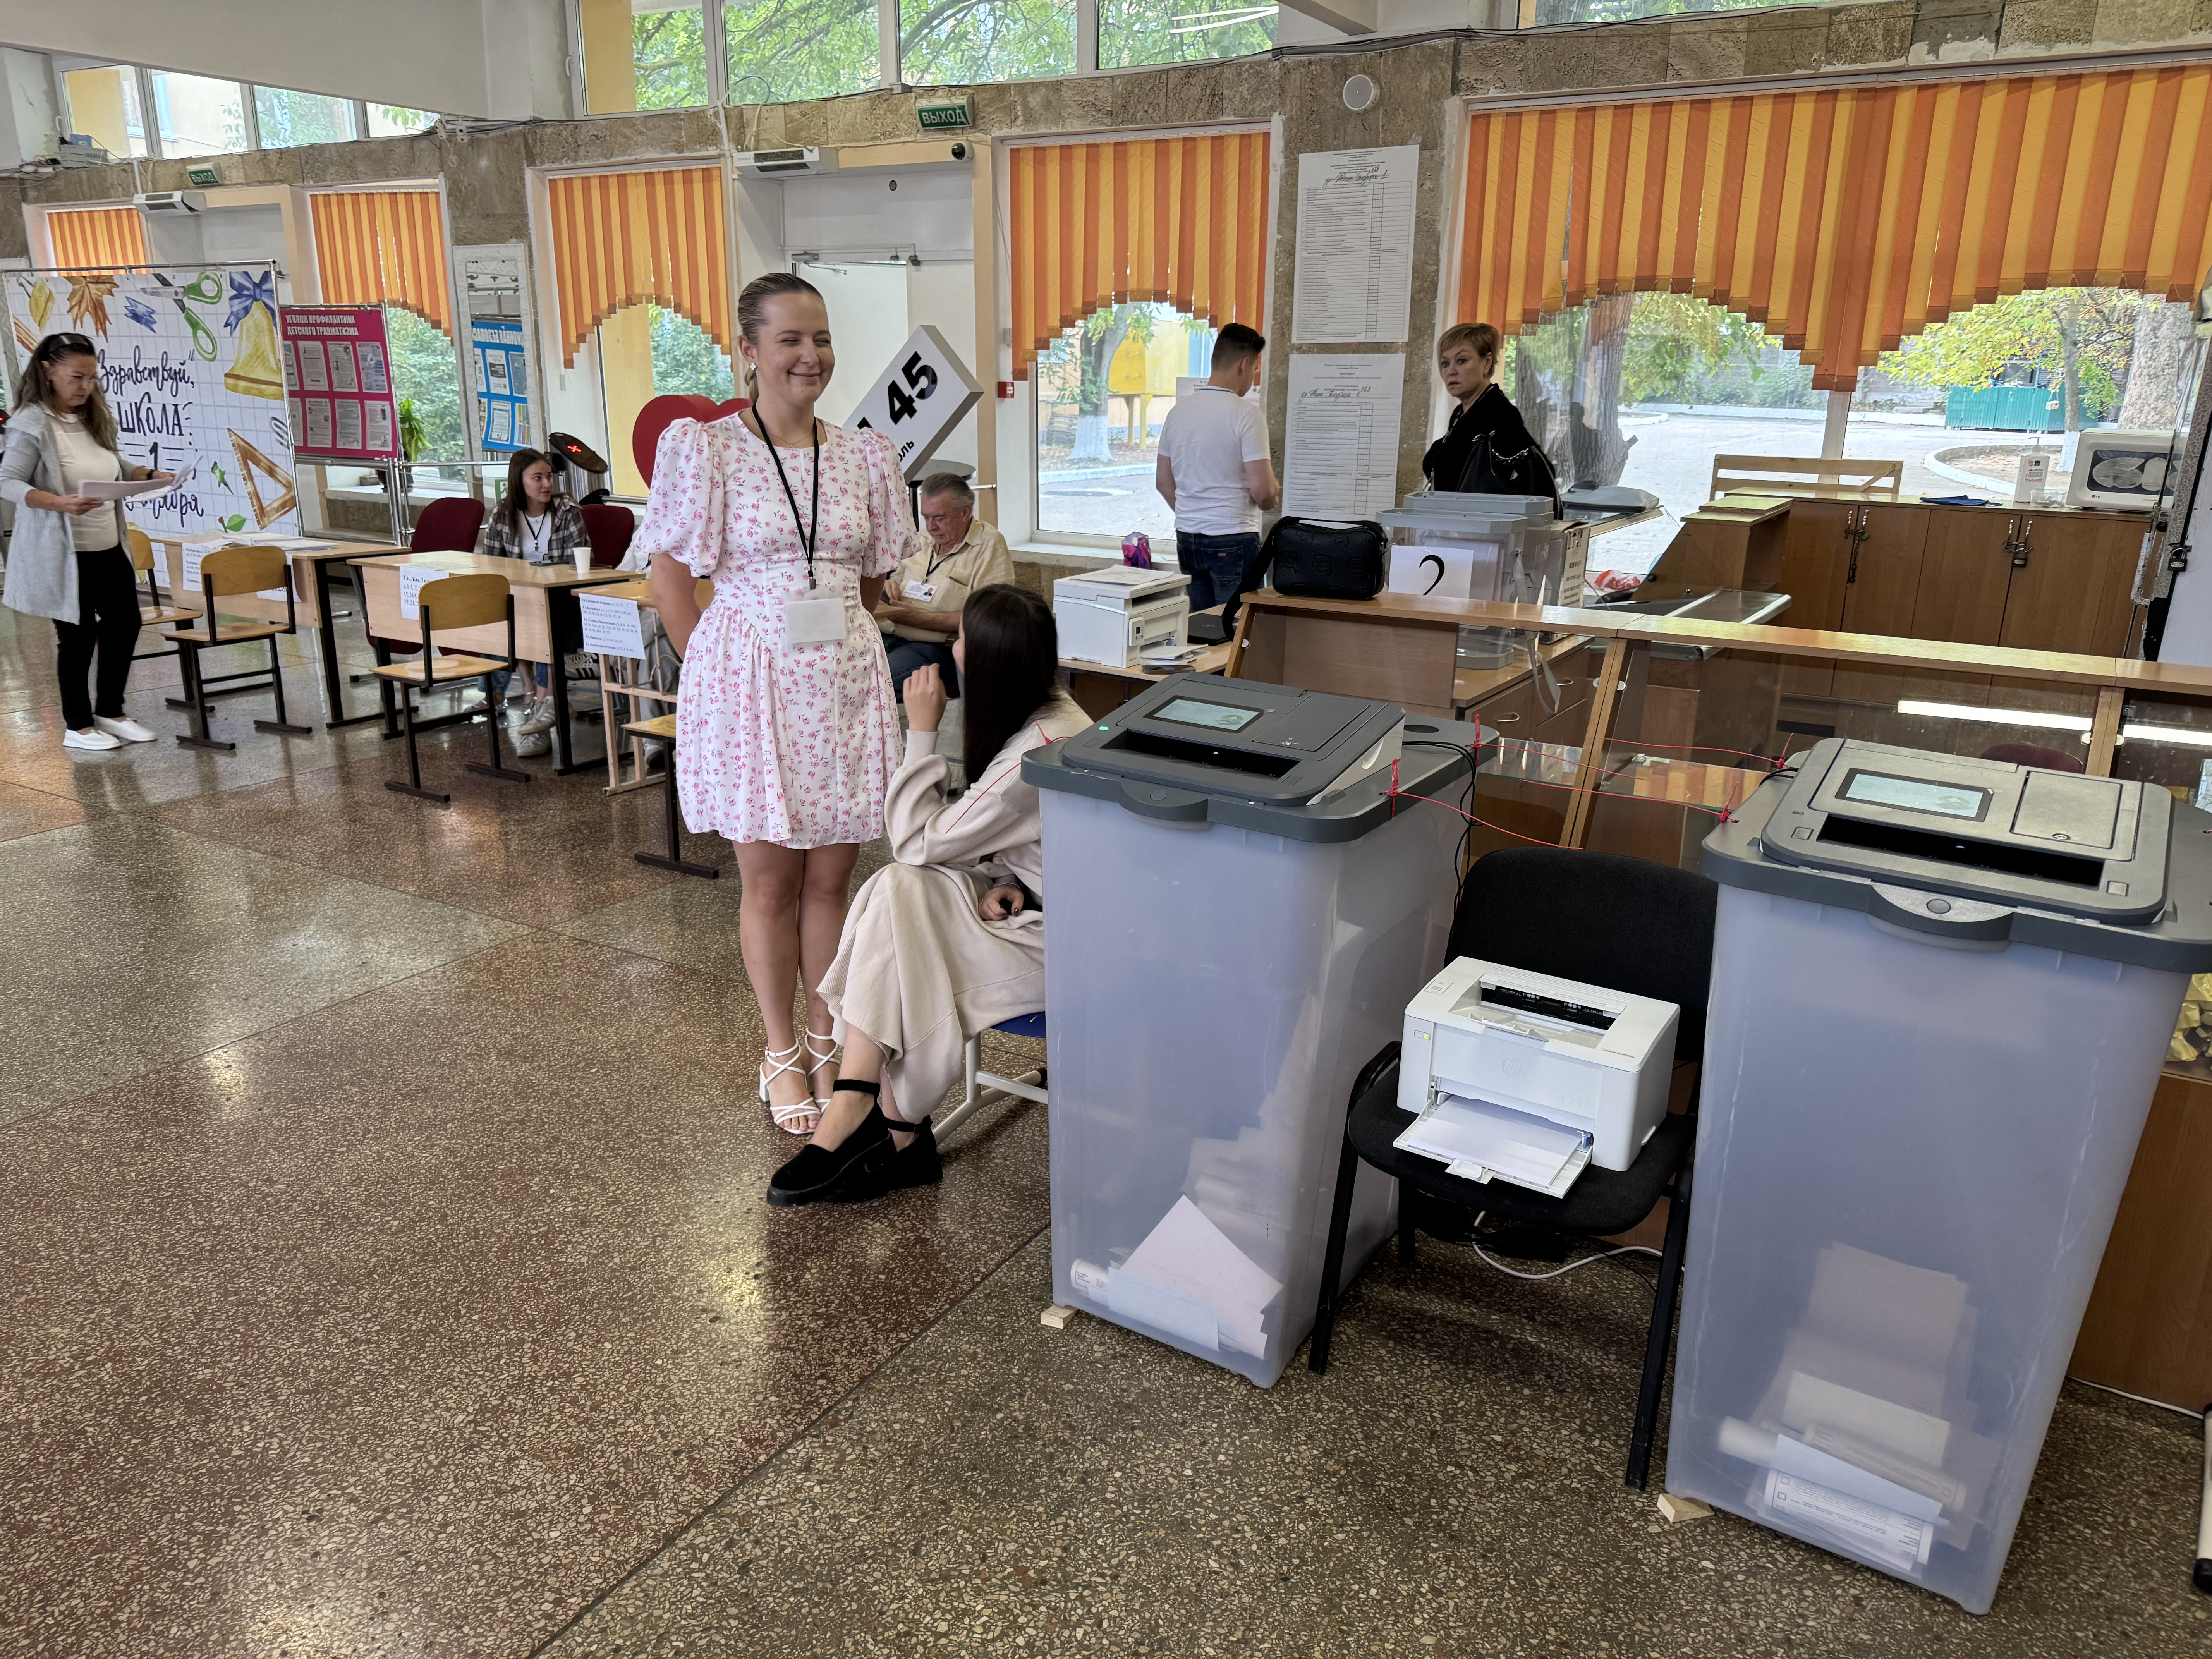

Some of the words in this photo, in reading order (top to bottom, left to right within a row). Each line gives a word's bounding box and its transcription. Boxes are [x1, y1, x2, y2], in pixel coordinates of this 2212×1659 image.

[922, 110, 968, 124] ВЫХОД
[190, 172, 216, 183] ВЫХОД
[888, 351, 938, 425] 45
[117, 392, 185, 436] ШКОЛА
[149, 441, 158, 471] 1
[1419, 554, 1445, 596] 2
